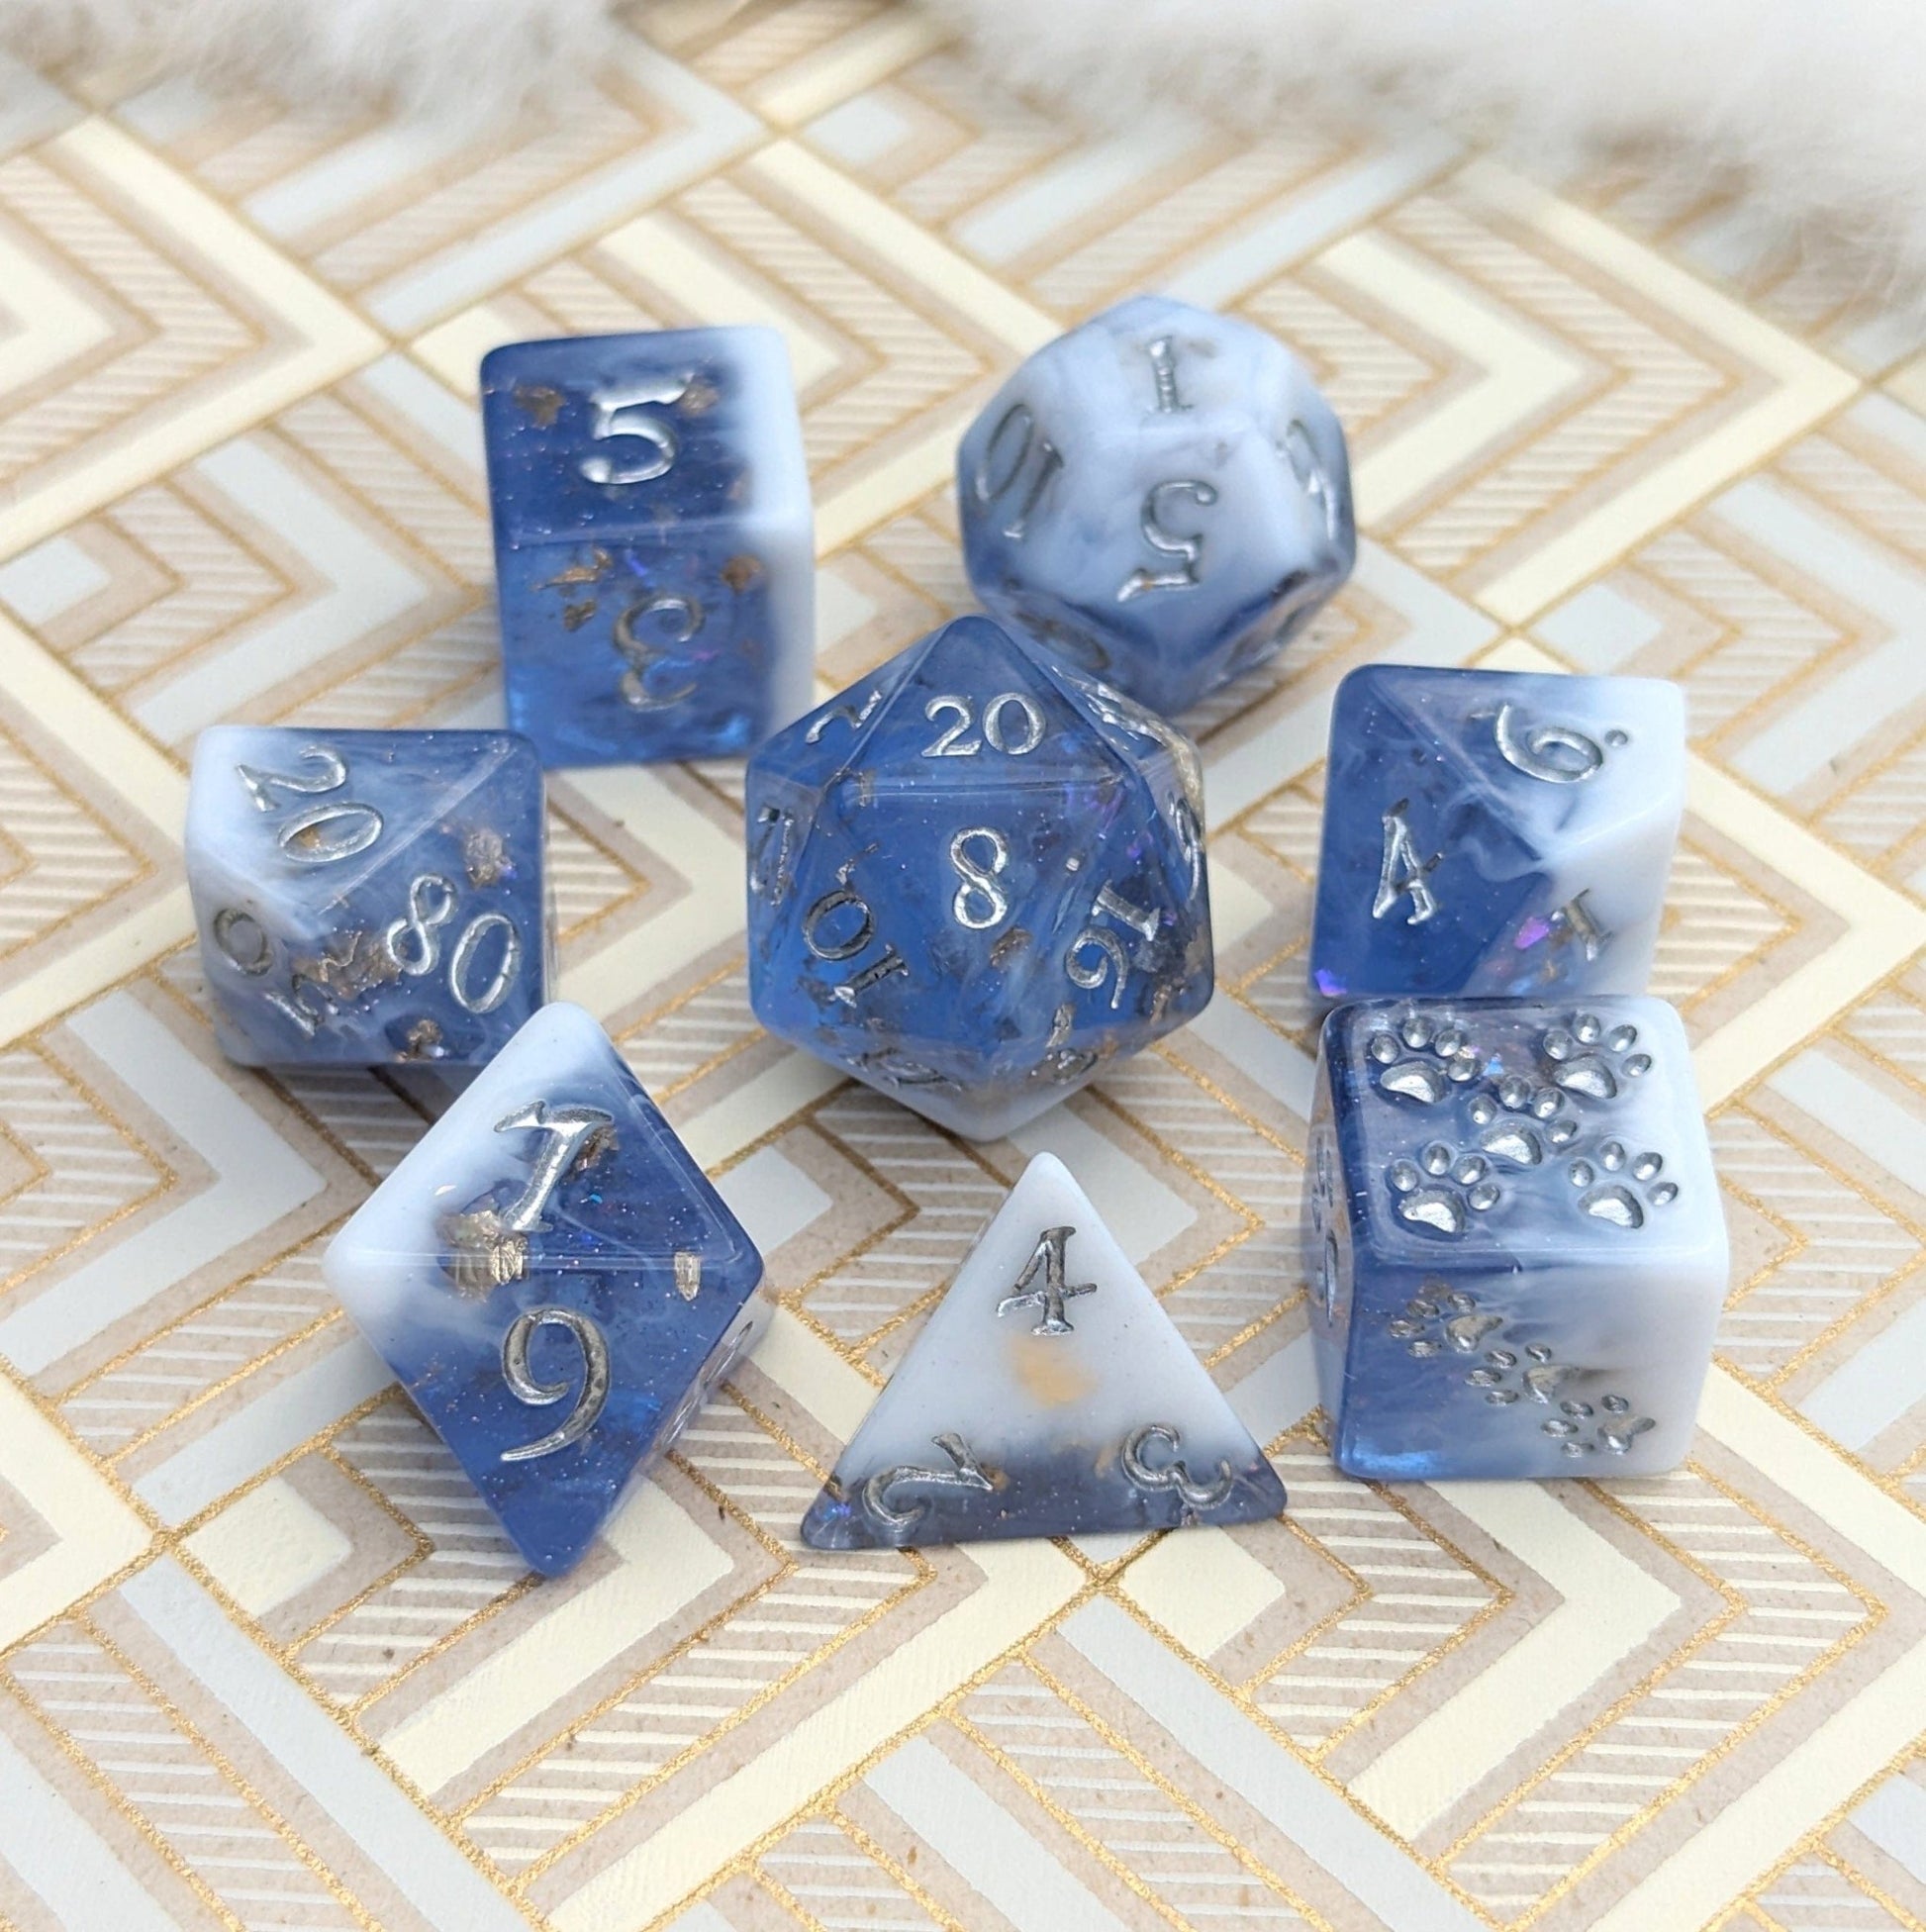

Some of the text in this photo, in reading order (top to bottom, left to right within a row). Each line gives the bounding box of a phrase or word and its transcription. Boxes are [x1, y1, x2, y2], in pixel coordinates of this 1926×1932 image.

[581, 372, 696, 485] 5
[1145, 335, 1195, 414] 1
[1116, 478, 1219, 604] 5
[612, 592, 706, 713] 3
[921, 692, 1046, 757] 20
[236, 744, 385, 863] 20
[950, 825, 1009, 930] 8
[387, 872, 522, 1014] 80
[802, 889, 910, 1009] 10
[494, 1099, 615, 1234] 7
[996, 1224, 1099, 1336] 4
[500, 1305, 612, 1462] 9
[863, 1432, 995, 1529] 2
[1119, 1422, 1233, 1511] 3
